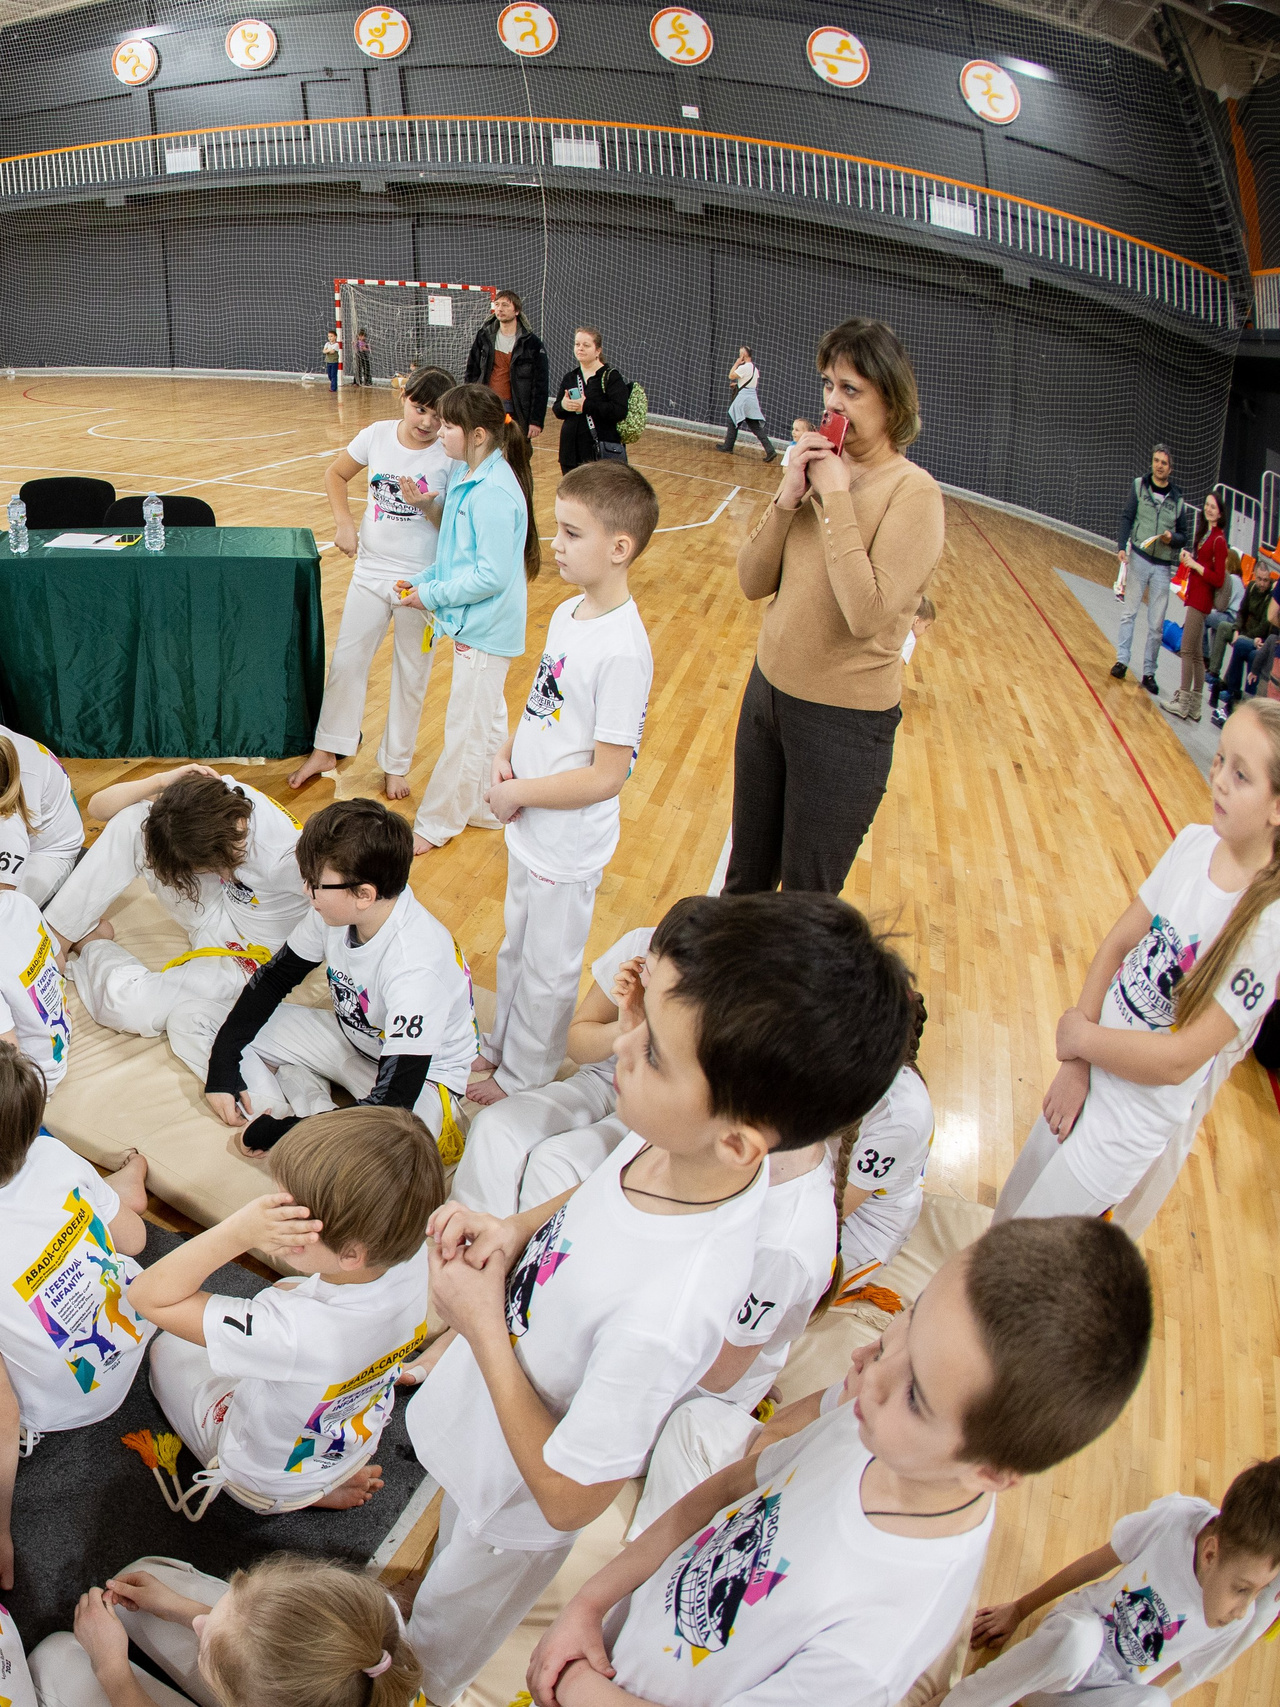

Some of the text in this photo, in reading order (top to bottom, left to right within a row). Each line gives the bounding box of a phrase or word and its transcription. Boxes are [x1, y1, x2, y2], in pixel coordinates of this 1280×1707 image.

[386, 514, 412, 522] RUSSIA
[1113, 990, 1133, 1026] RUSSIA
[1230, 967, 1265, 1011] 68
[389, 1014, 424, 1039] 28
[857, 1148, 896, 1178] 33
[25, 1207, 86, 1286] ABADÁ-CAPOEIRA
[48, 1258, 82, 1295] FESTIVAL
[50, 1270, 85, 1309] INFANTIL
[736, 1292, 776, 1330] 57
[753, 1501, 782, 1584] VORONEZH
[665, 1563, 686, 1614] RUSSIA
